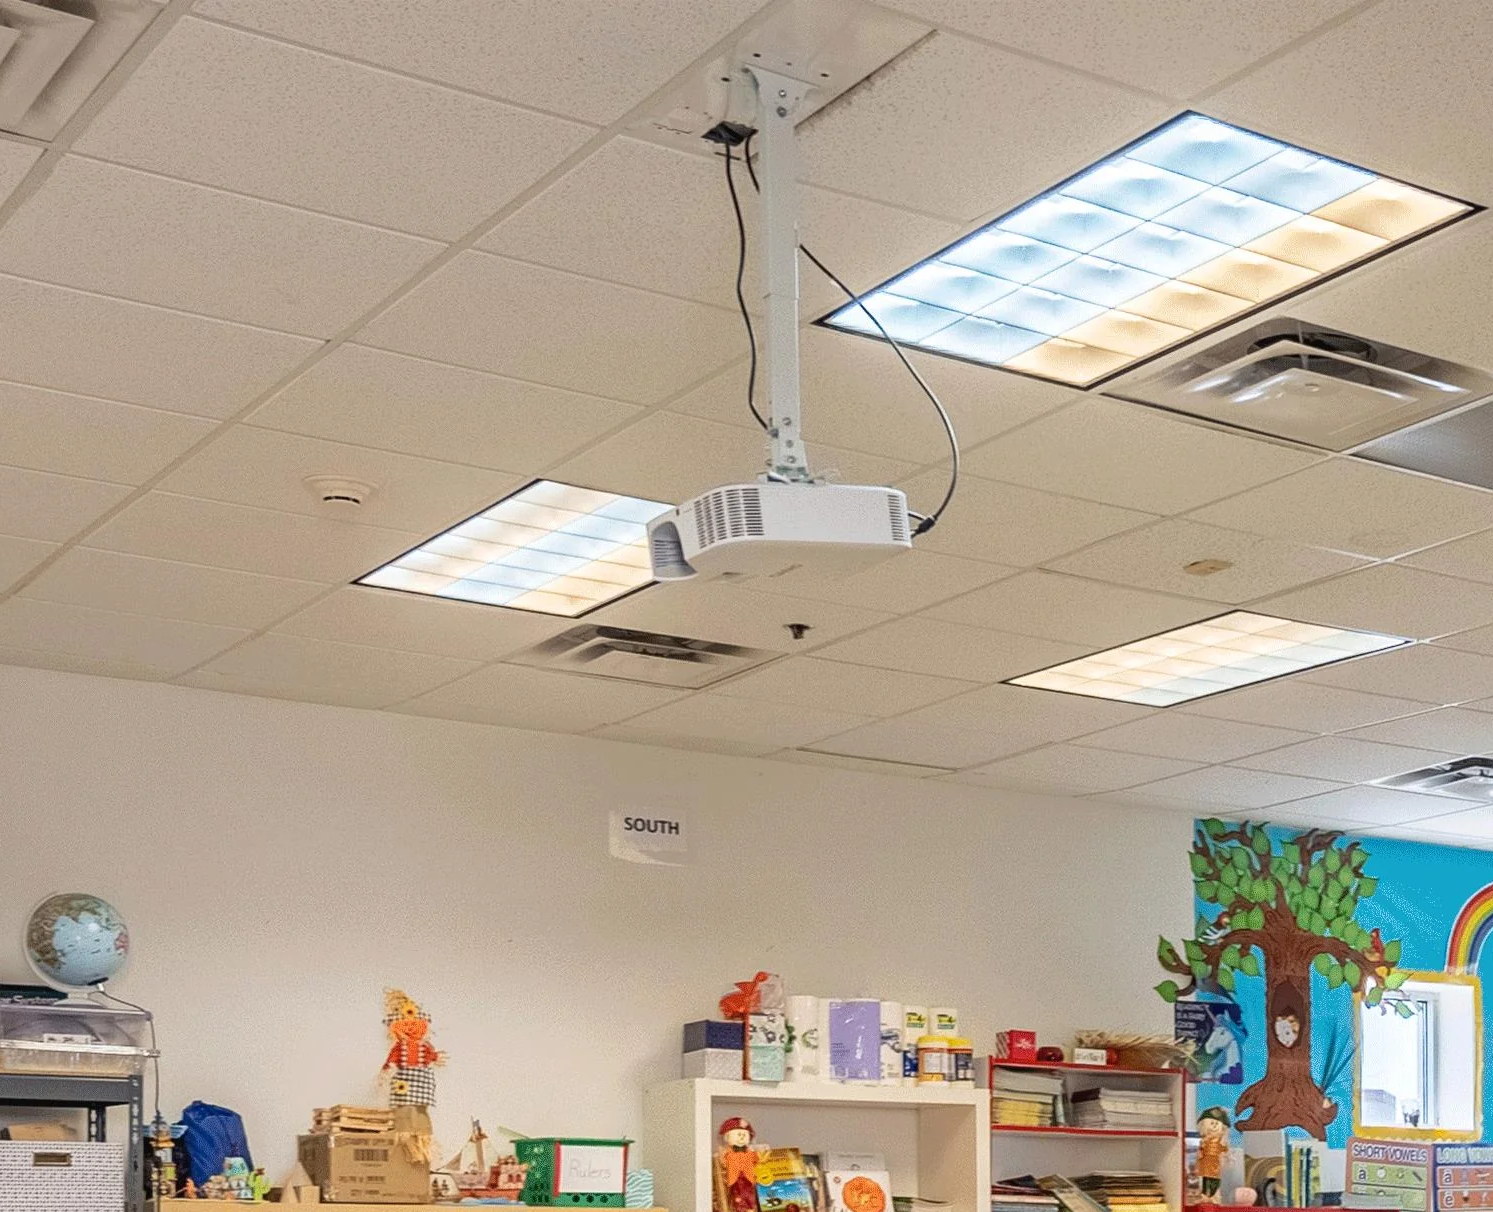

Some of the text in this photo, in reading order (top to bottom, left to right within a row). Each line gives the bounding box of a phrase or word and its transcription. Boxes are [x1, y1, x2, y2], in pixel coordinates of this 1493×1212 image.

[624, 816, 680, 836] SOUTH
[1354, 1145, 1427, 1162] SHORT VOWELS
[569, 1157, 612, 1178] Rulers
